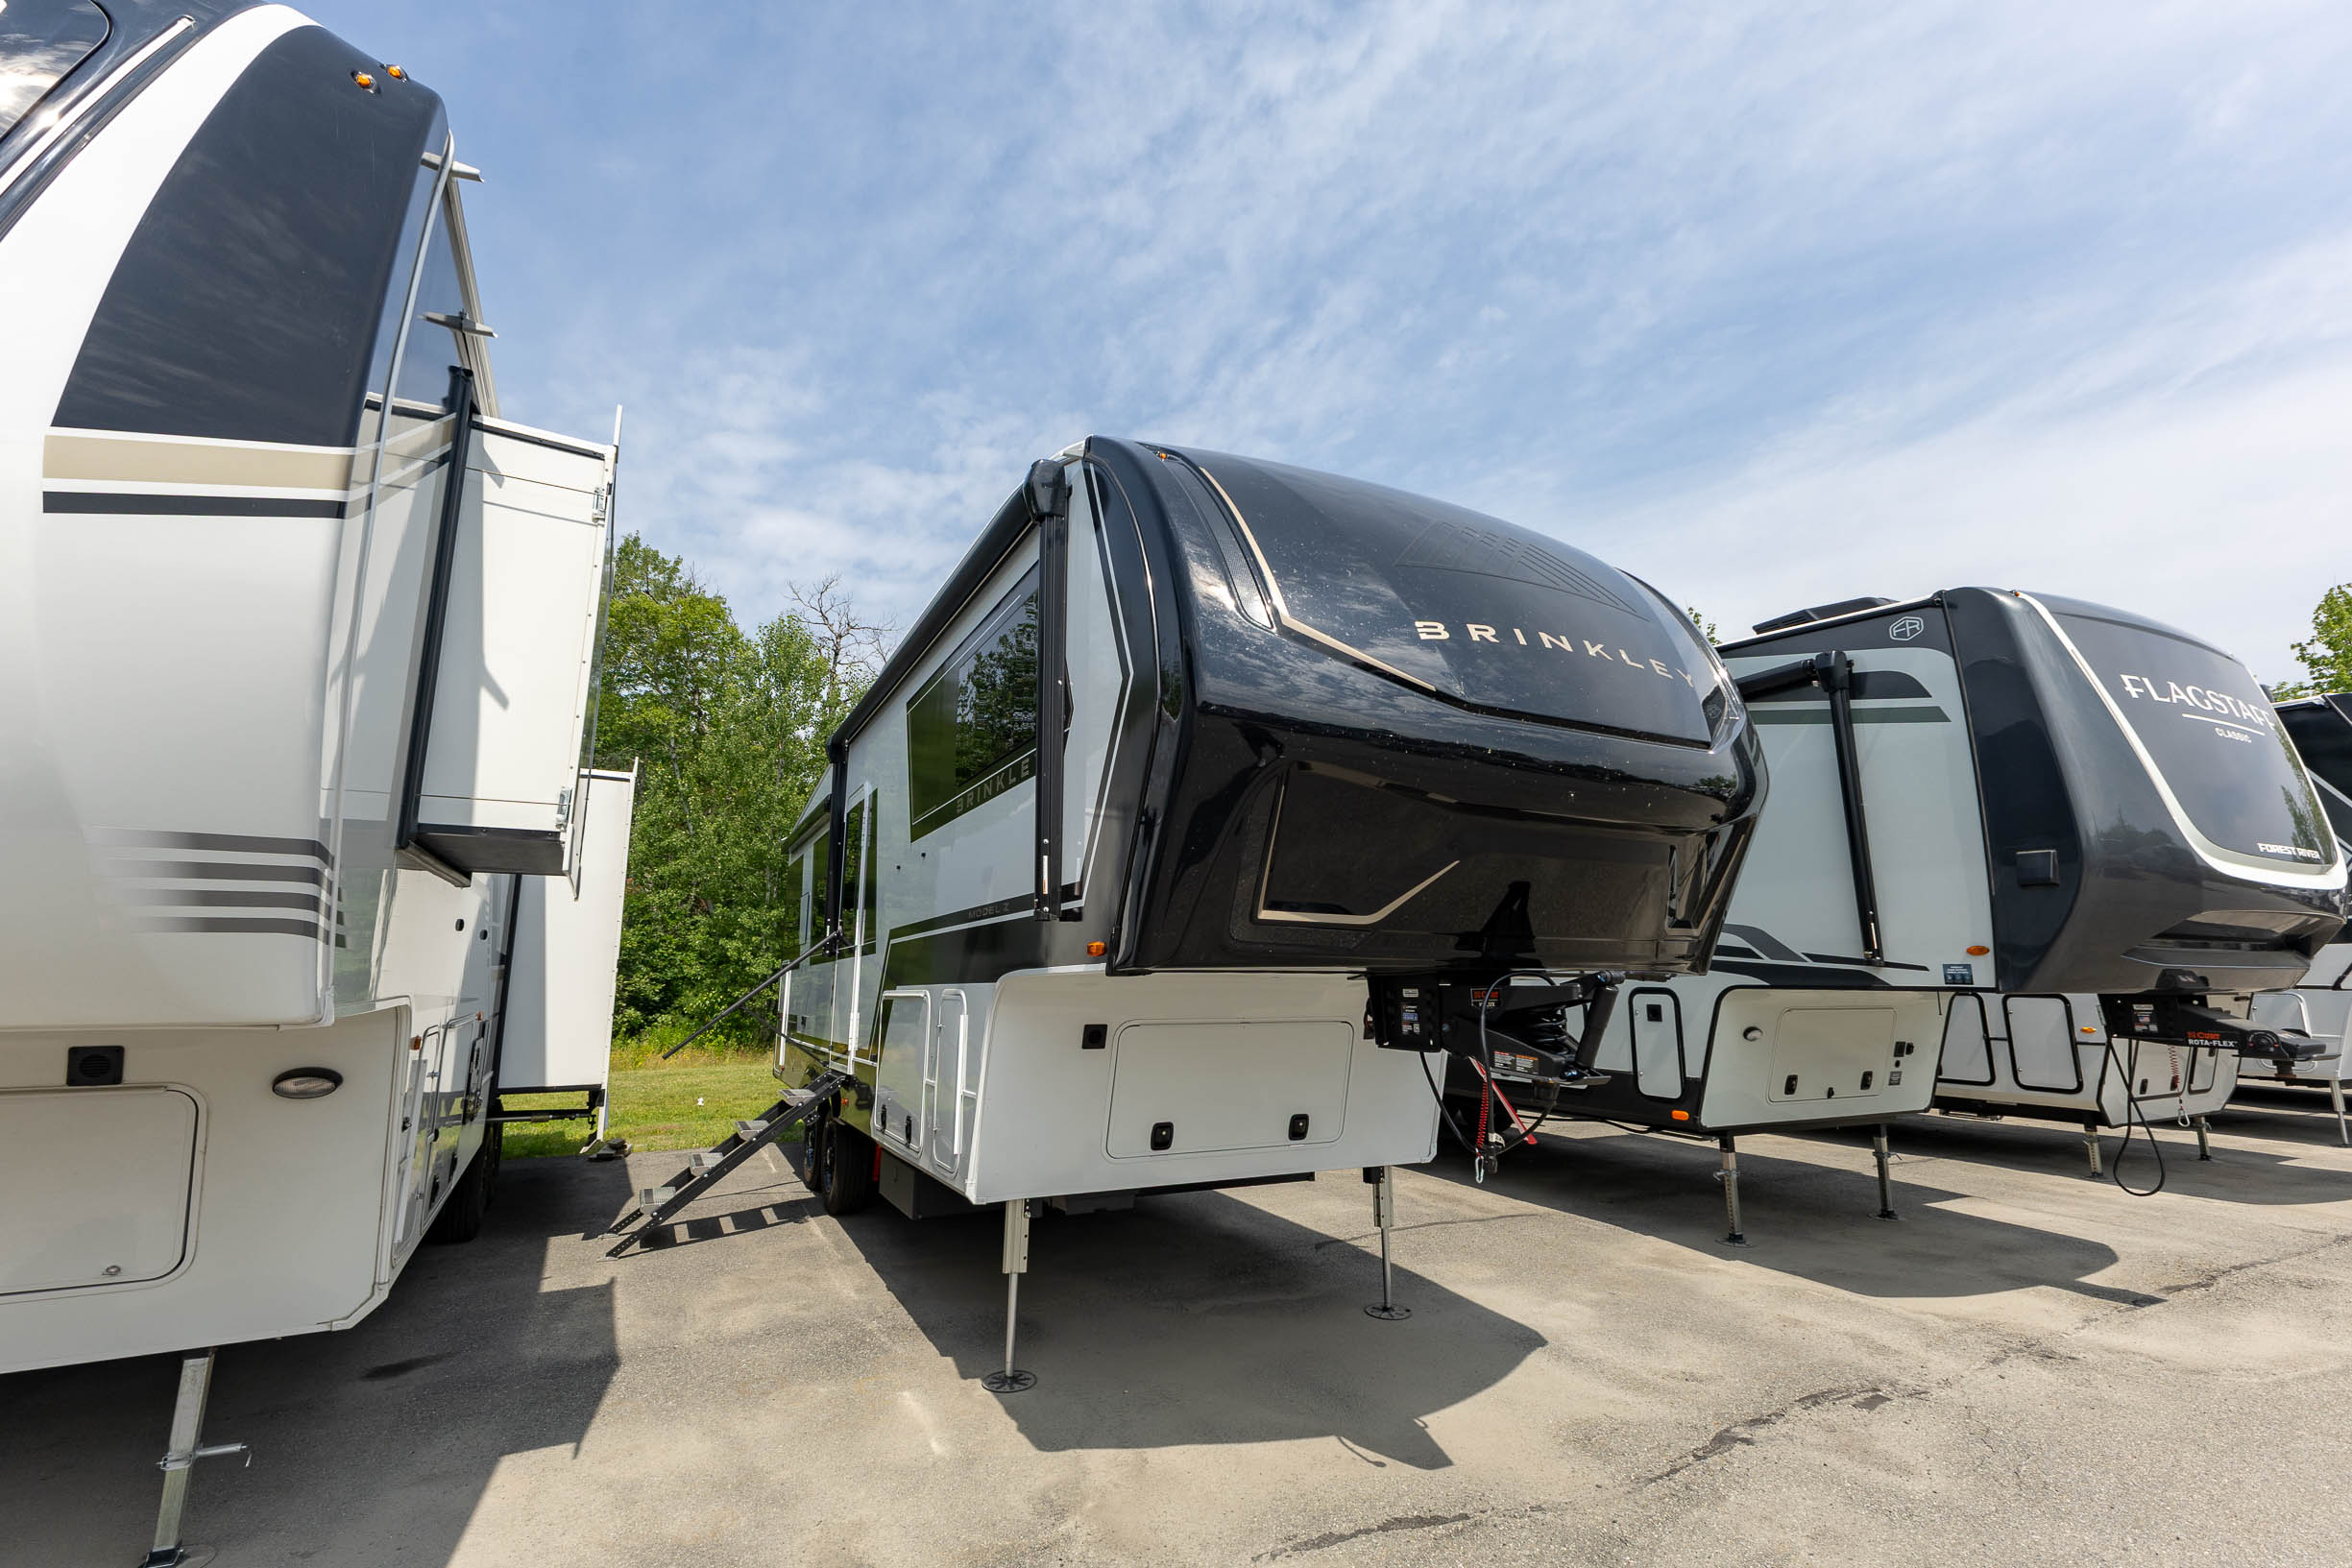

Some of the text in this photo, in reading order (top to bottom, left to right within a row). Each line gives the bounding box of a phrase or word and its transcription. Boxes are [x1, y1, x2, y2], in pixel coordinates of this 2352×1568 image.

[1414, 620, 1694, 688] BRINKLEY
[2120, 674, 2276, 731] FLAGSTAFF
[2215, 727, 2252, 743] CLASSIC
[957, 755, 1036, 814] BRINKLE
[2257, 842, 2321, 860] FOREST RIVER
[967, 905, 1000, 919] MODEL
